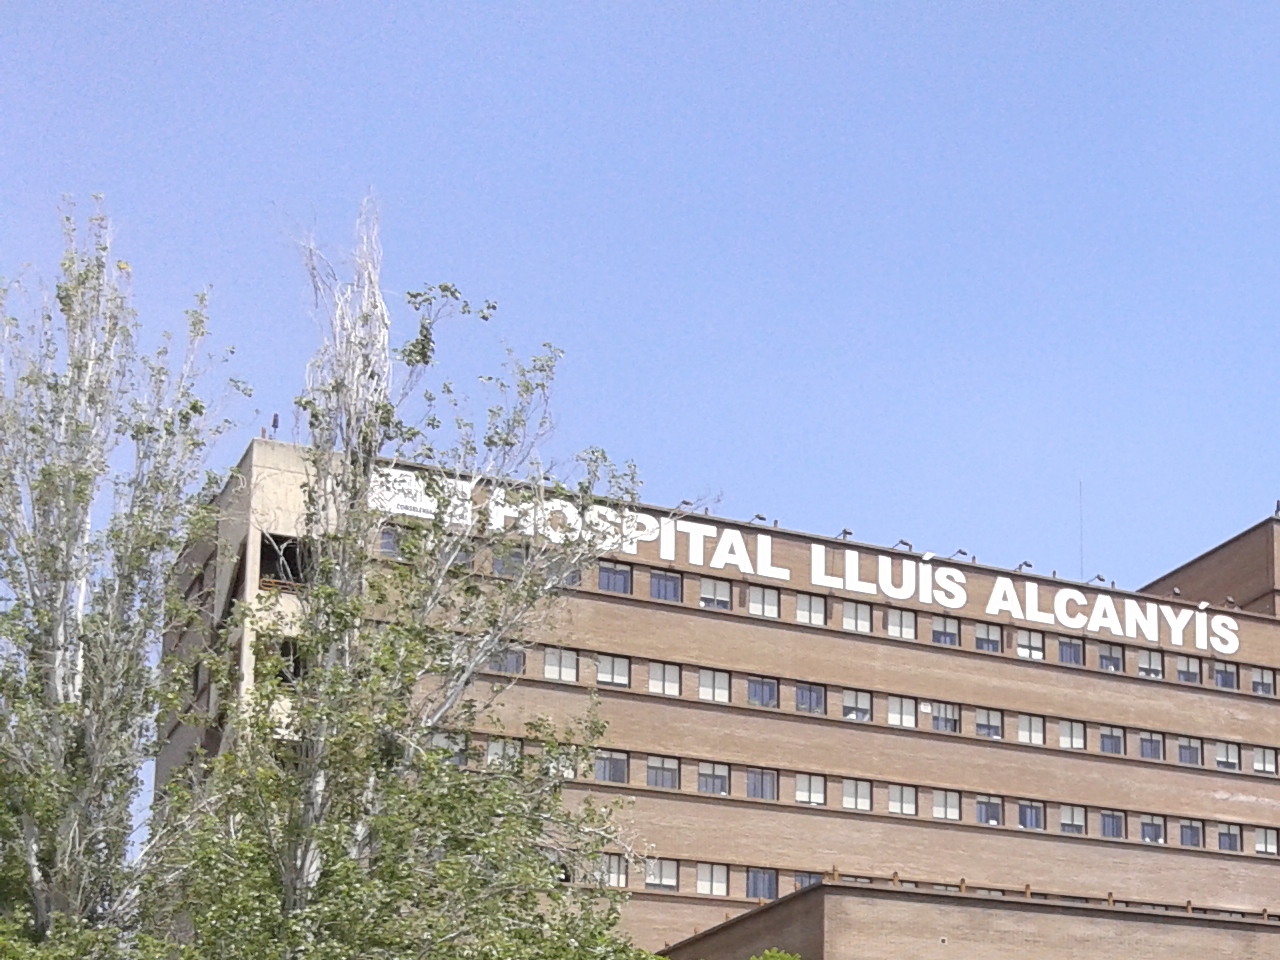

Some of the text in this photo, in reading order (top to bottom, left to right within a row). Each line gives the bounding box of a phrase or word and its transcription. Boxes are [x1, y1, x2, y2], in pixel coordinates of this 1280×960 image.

[488, 486, 1240, 655] HOSPITAL LLUÍS ALCANYÍS
